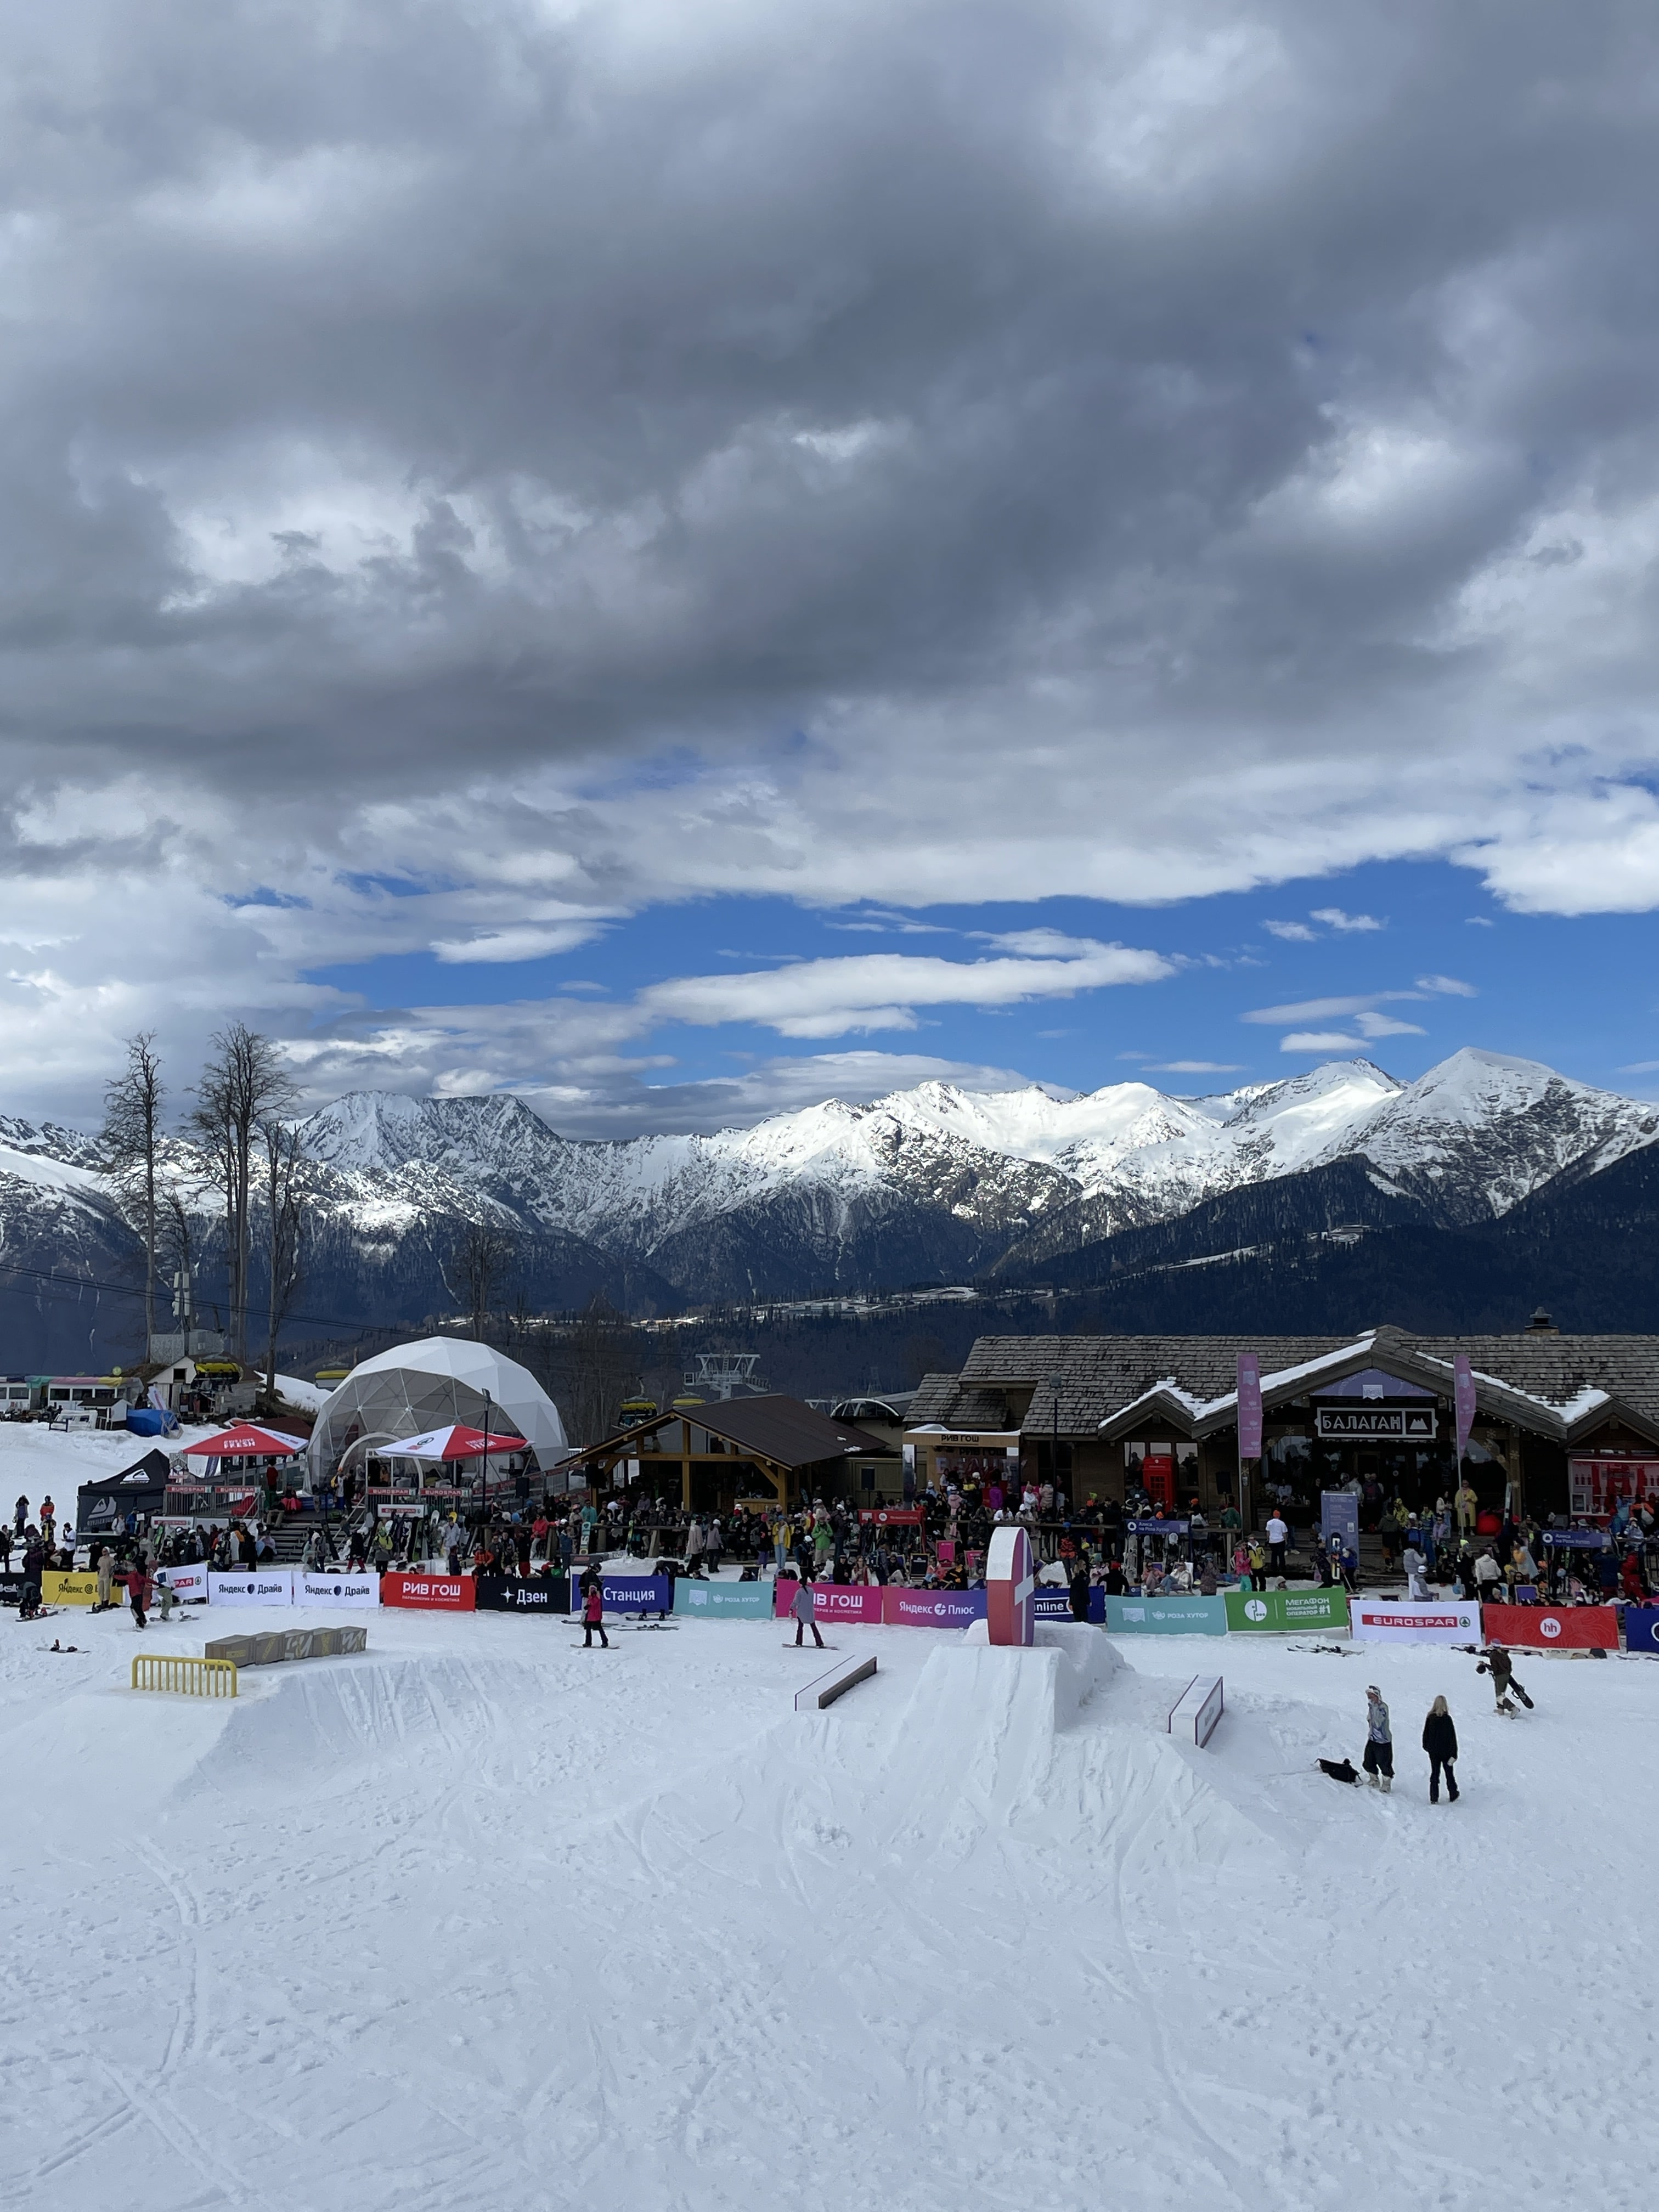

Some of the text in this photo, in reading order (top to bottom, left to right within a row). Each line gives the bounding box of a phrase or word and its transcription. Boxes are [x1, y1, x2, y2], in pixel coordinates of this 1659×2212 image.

[1322, 1416, 1401, 1429] БАЛАГАН
[59, 1584, 83, 1593] Яндекс
[219, 1584, 282, 1594] Яндекс Драйв
[305, 1585, 370, 1596] Яндекс Драйв
[403, 1582, 460, 1596] РИВ ГОШ
[516, 1589, 548, 1605] Дзен
[603, 1587, 655, 1602] Станция
[830, 1595, 862, 1607] ГОШ
[1034, 1602, 1064, 1611] nline
[899, 1601, 974, 1615] Яндекс Плюс
[1319, 1604, 1330, 1615] #1
[1373, 1616, 1454, 1626] EUROSPAR
[1544, 1622, 1557, 1633] hh
